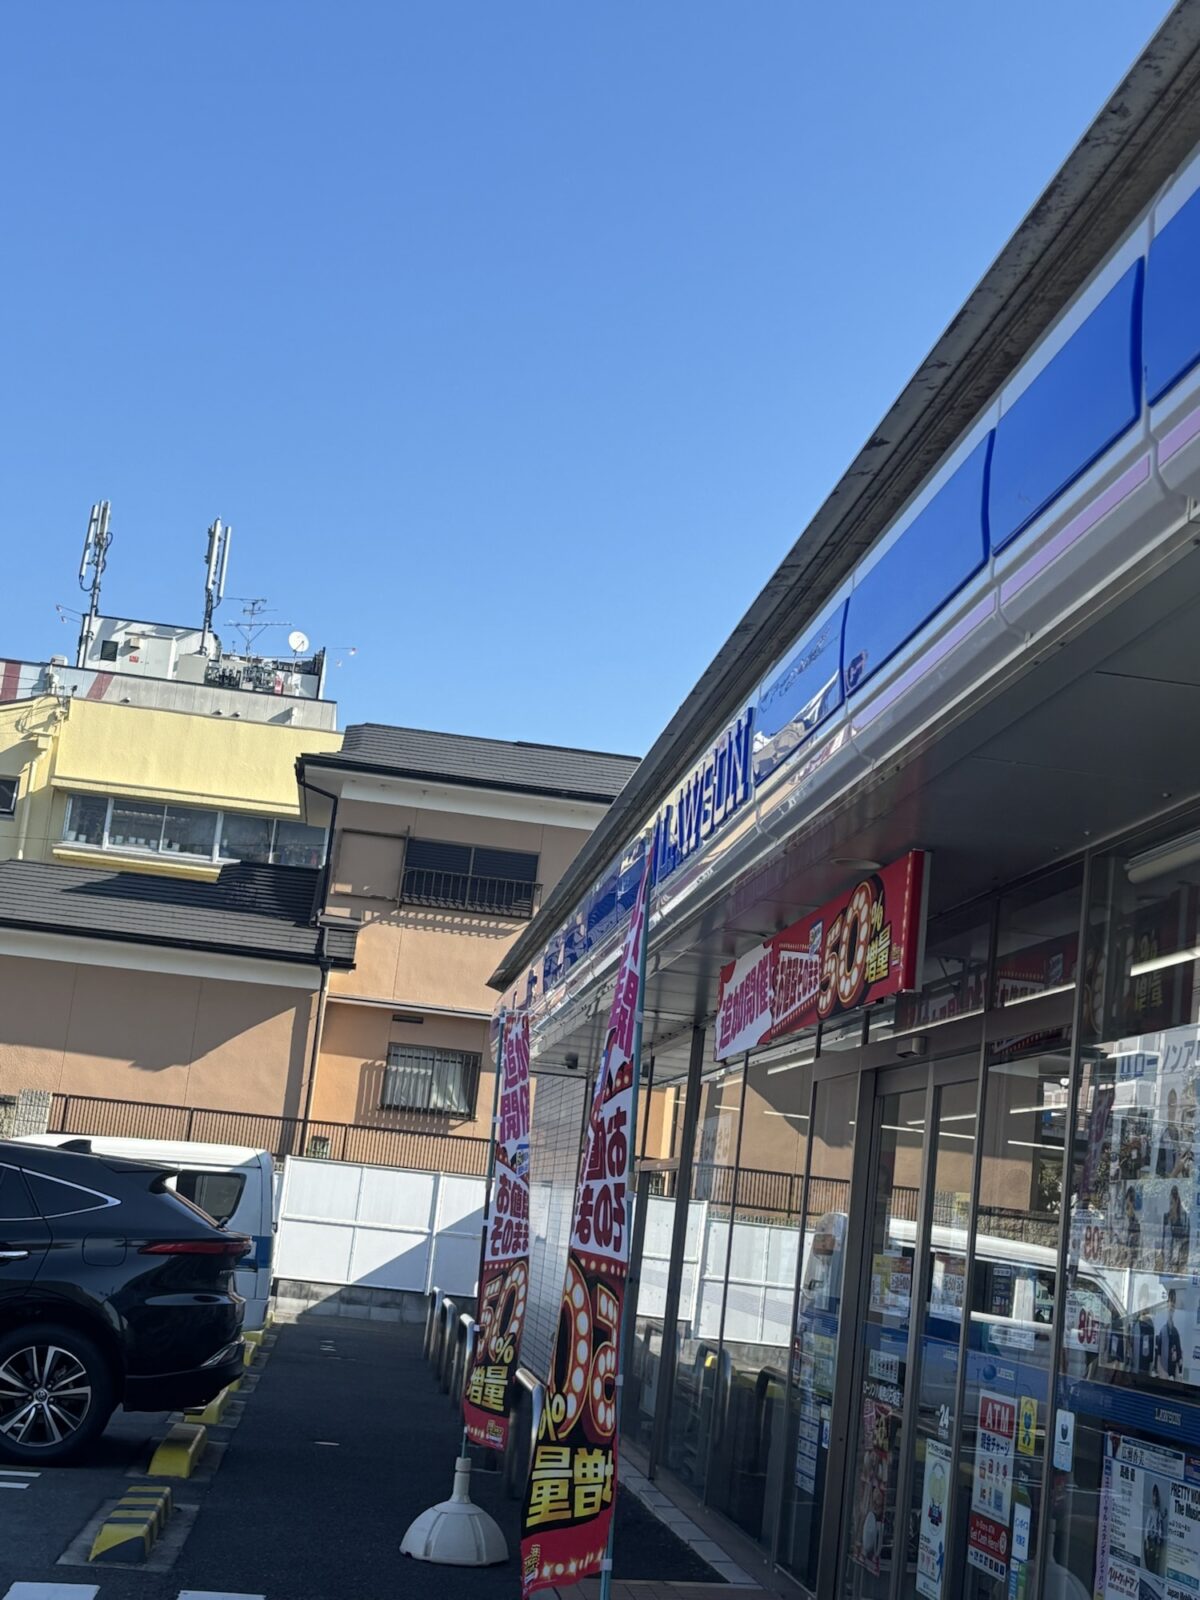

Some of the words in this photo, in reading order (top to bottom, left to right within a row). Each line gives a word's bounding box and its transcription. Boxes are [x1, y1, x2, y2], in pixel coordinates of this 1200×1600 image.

[656, 706, 757, 883] LAWSON
[720, 953, 771, 1047] 追加開催
[466, 1364, 509, 1412] 増量
[938, 1404, 950, 1430] 24
[985, 1401, 1010, 1433] ATM
[1154, 1407, 1182, 1427] LAWSON
[1170, 1482, 1191, 1504] PRETTY
[1174, 1499, 1185, 1518] The
